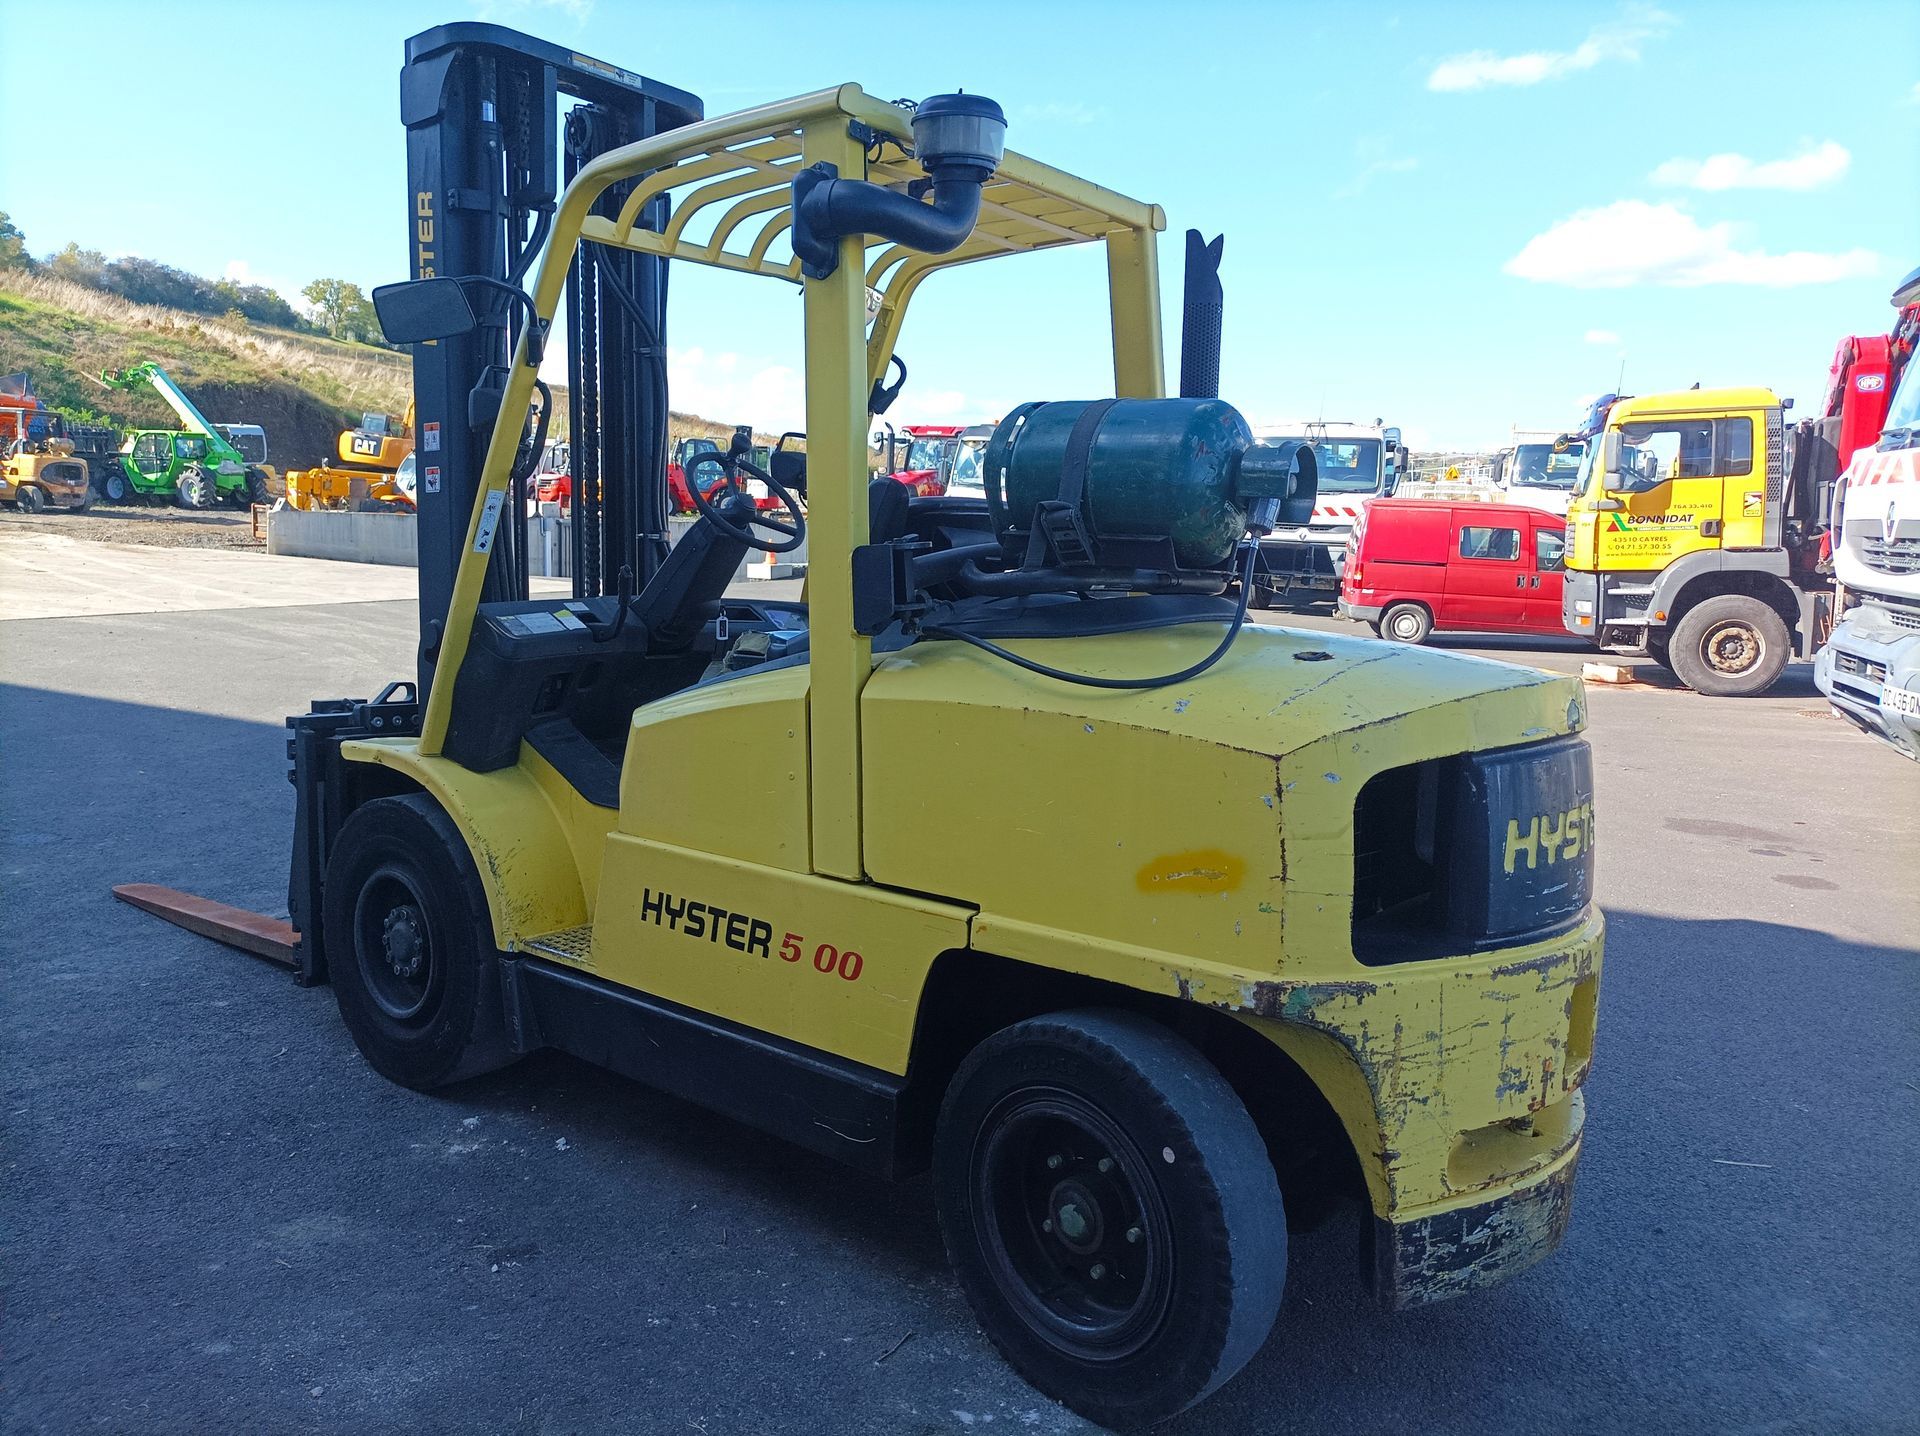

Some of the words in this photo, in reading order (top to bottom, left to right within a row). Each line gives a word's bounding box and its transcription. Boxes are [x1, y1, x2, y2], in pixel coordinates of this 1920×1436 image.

[354, 438, 377, 455] CAT
[1627, 514, 1694, 525] BONNIDAT
[640, 887, 773, 959] HYSTER
